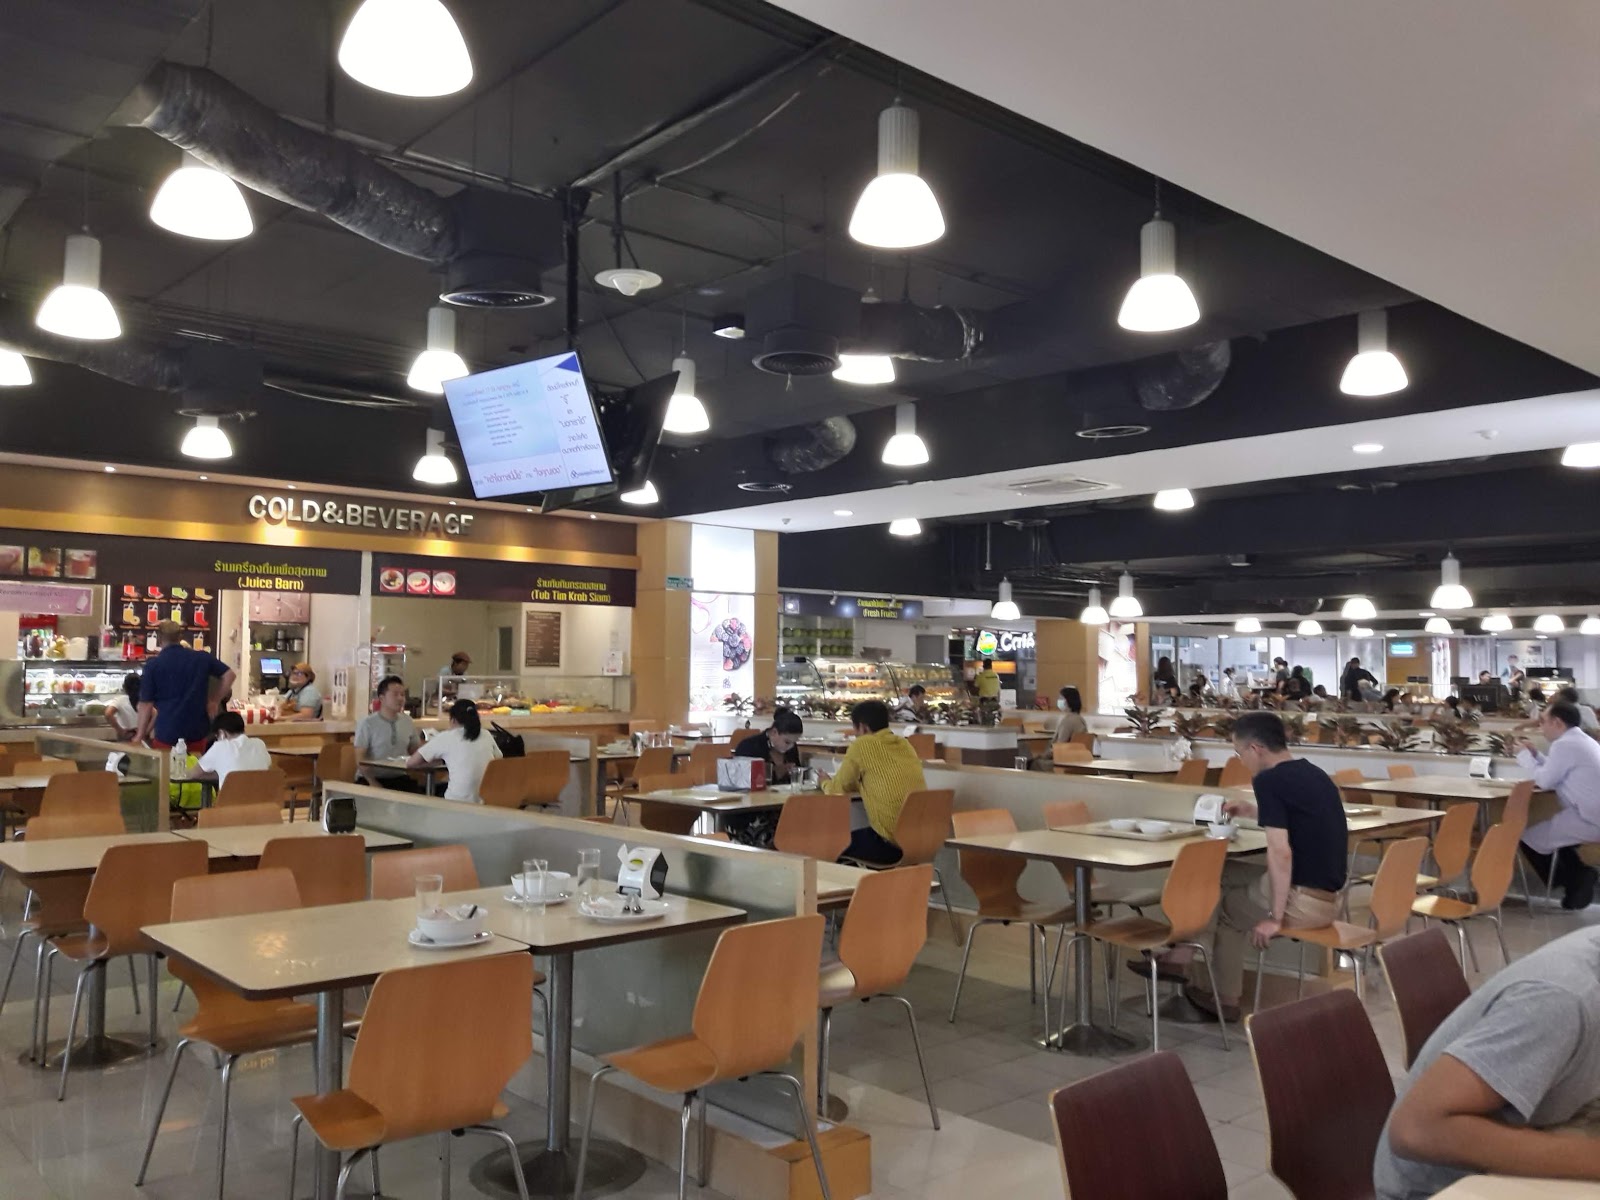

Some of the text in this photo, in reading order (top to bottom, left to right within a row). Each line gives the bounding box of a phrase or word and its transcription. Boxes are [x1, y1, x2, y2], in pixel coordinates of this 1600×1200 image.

[248, 494, 474, 534] COLD&BEVERAGE
[238, 576, 304, 591] (Juice Barn)
[531, 589, 611, 604] (Tub Tim Krob Siam)
[863, 608, 880, 618] (Fresh
